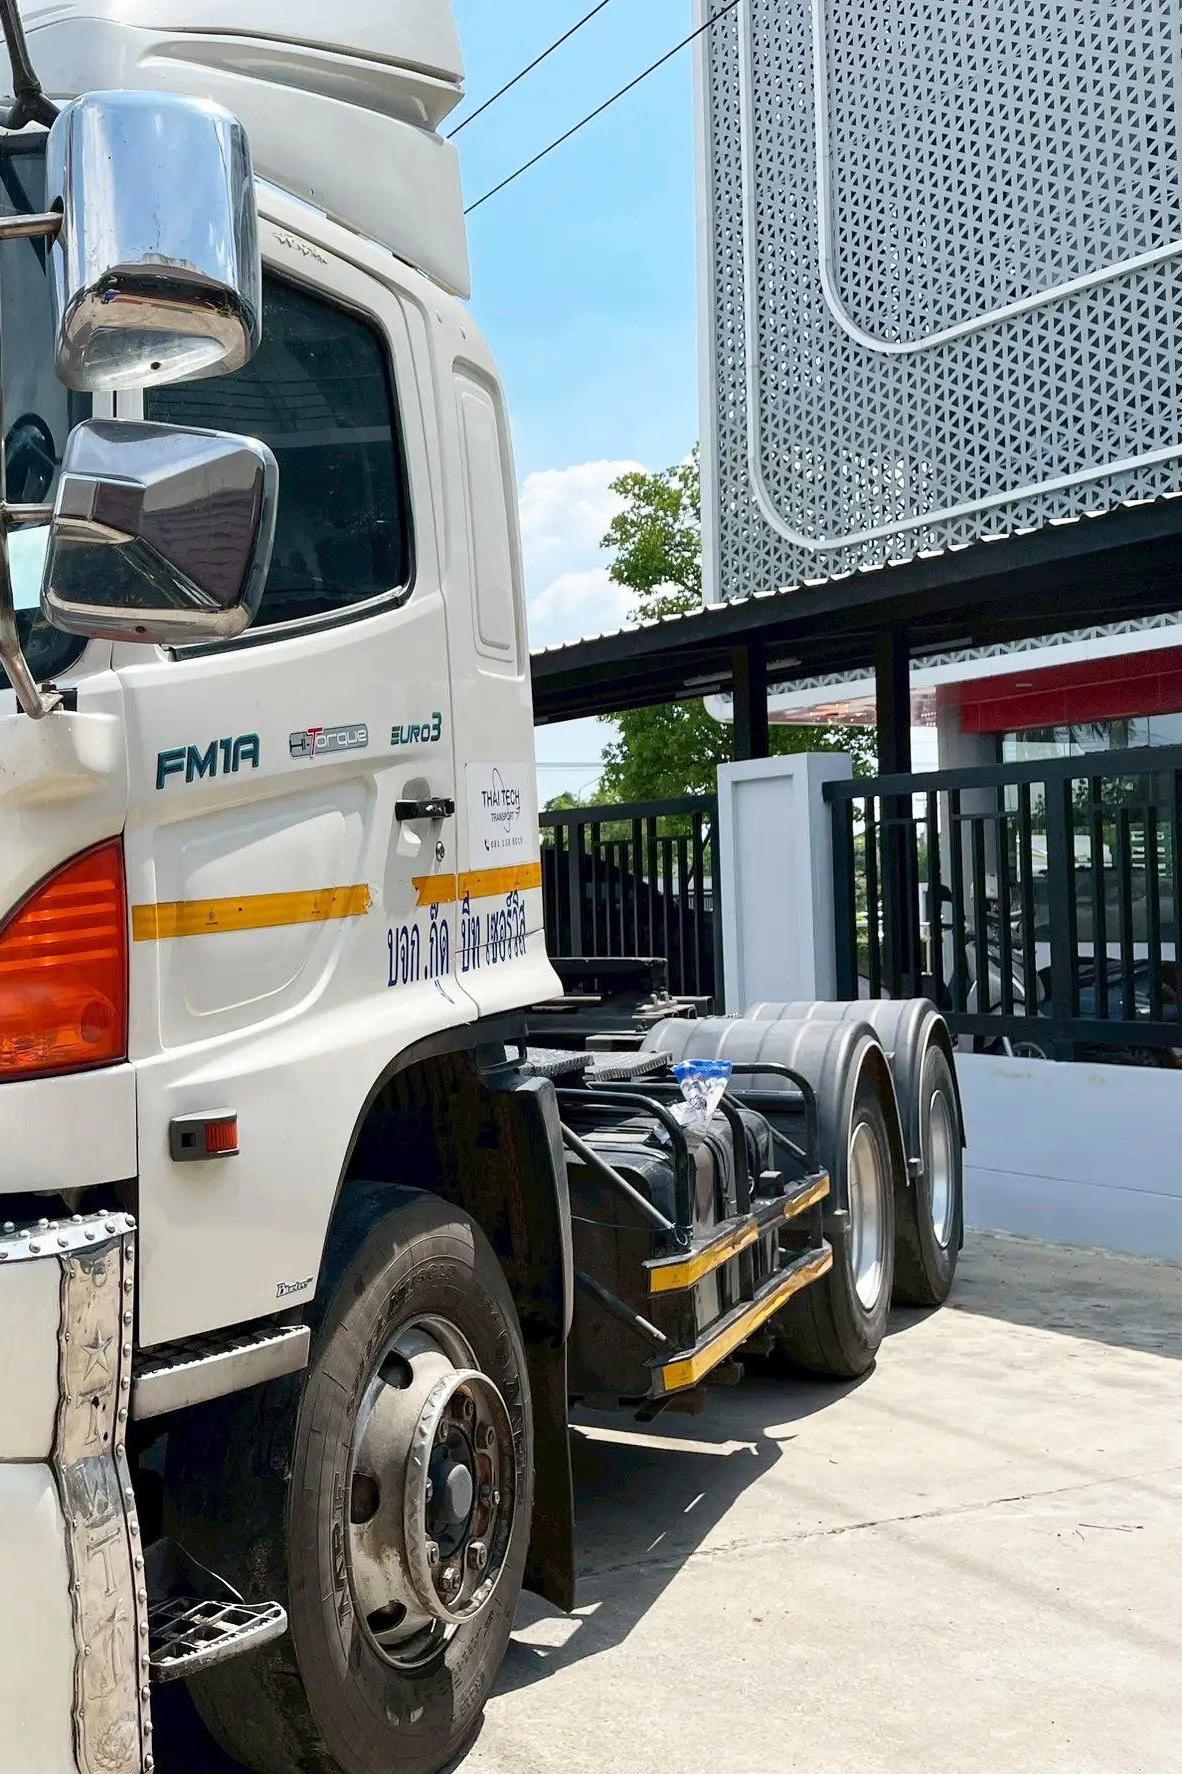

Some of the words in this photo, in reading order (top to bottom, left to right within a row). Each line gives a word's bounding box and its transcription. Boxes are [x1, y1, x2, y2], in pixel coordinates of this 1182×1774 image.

[155, 732, 261, 790] FM1A
[481, 789, 500, 807] THAI
[501, 788, 521, 806] TECH
